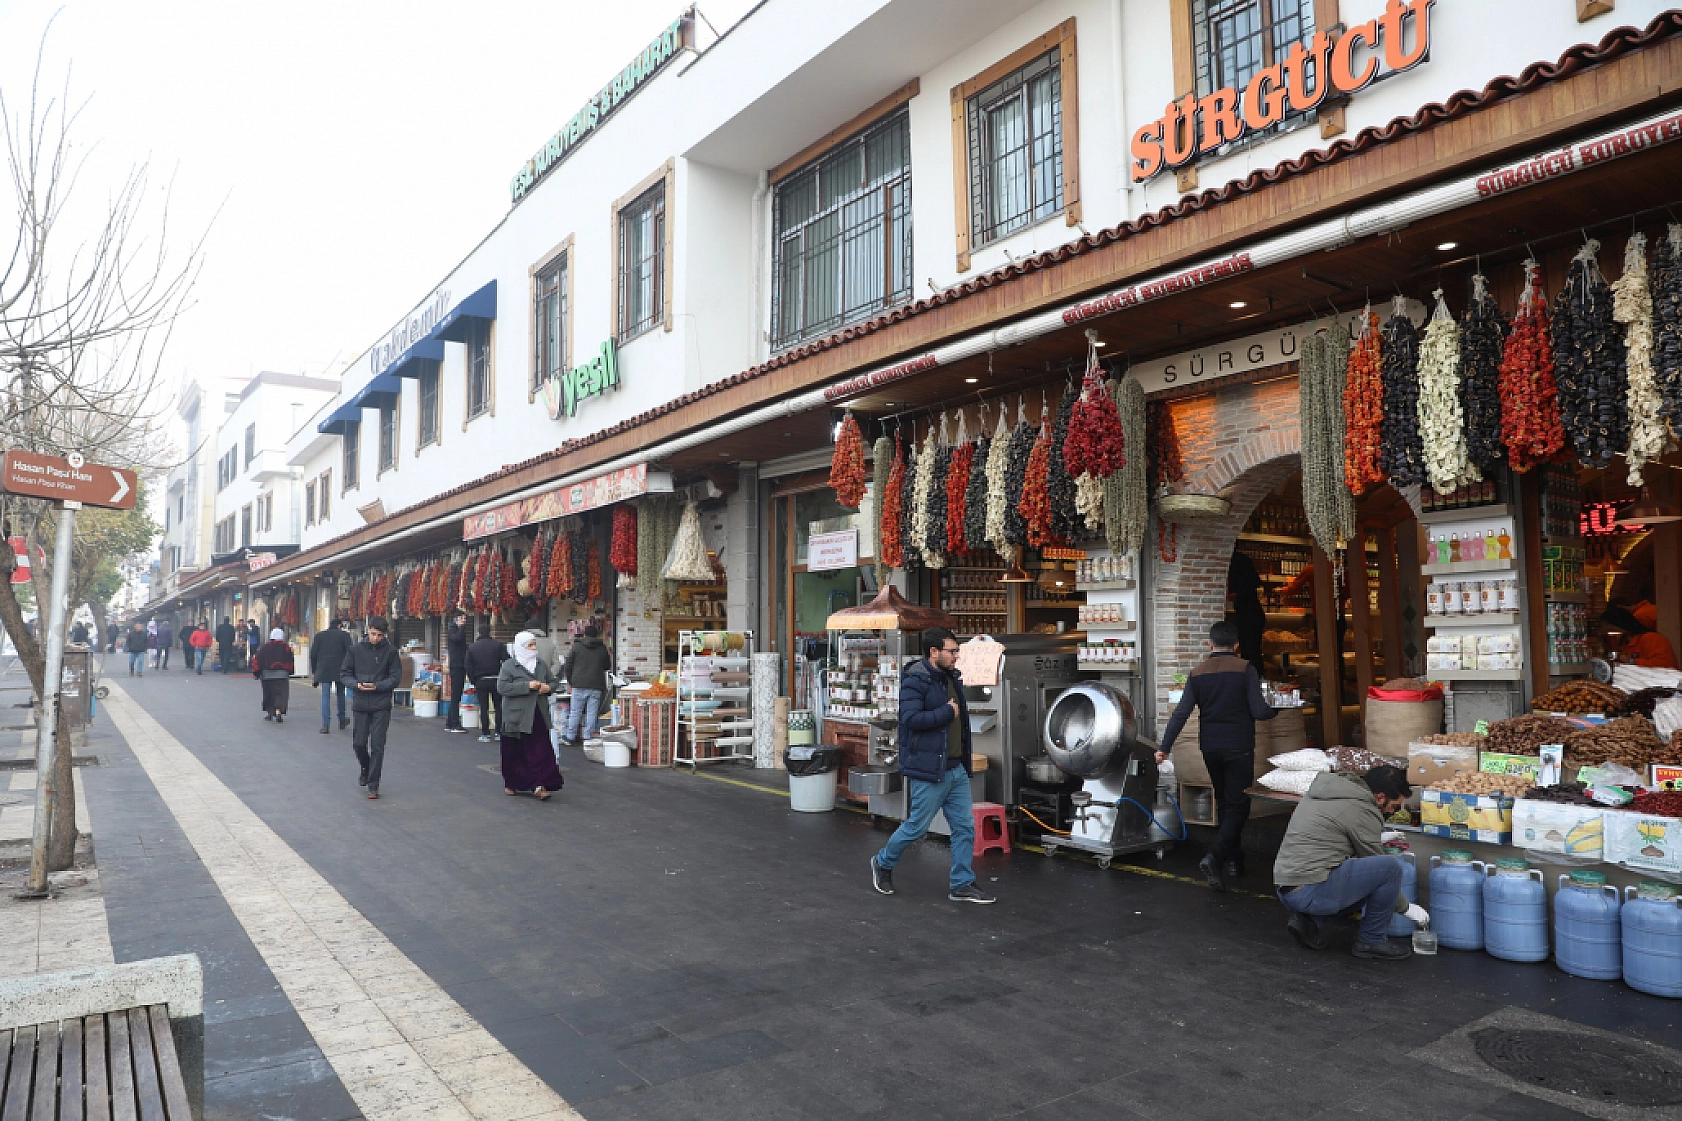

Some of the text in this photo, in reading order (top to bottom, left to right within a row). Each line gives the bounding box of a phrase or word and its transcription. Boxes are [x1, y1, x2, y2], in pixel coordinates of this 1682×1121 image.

[613, 18, 681, 107] BAHARAT
[1131, 0, 1434, 181] SÜRGÜCÜ
[1476, 145, 1575, 197] SÜRGÜCÜ
[1062, 286, 1139, 325] SÜRGÜCÜ
[1164, 316, 1361, 383] SÜRGÜÜ
[13, 461, 44, 474] Hasan
